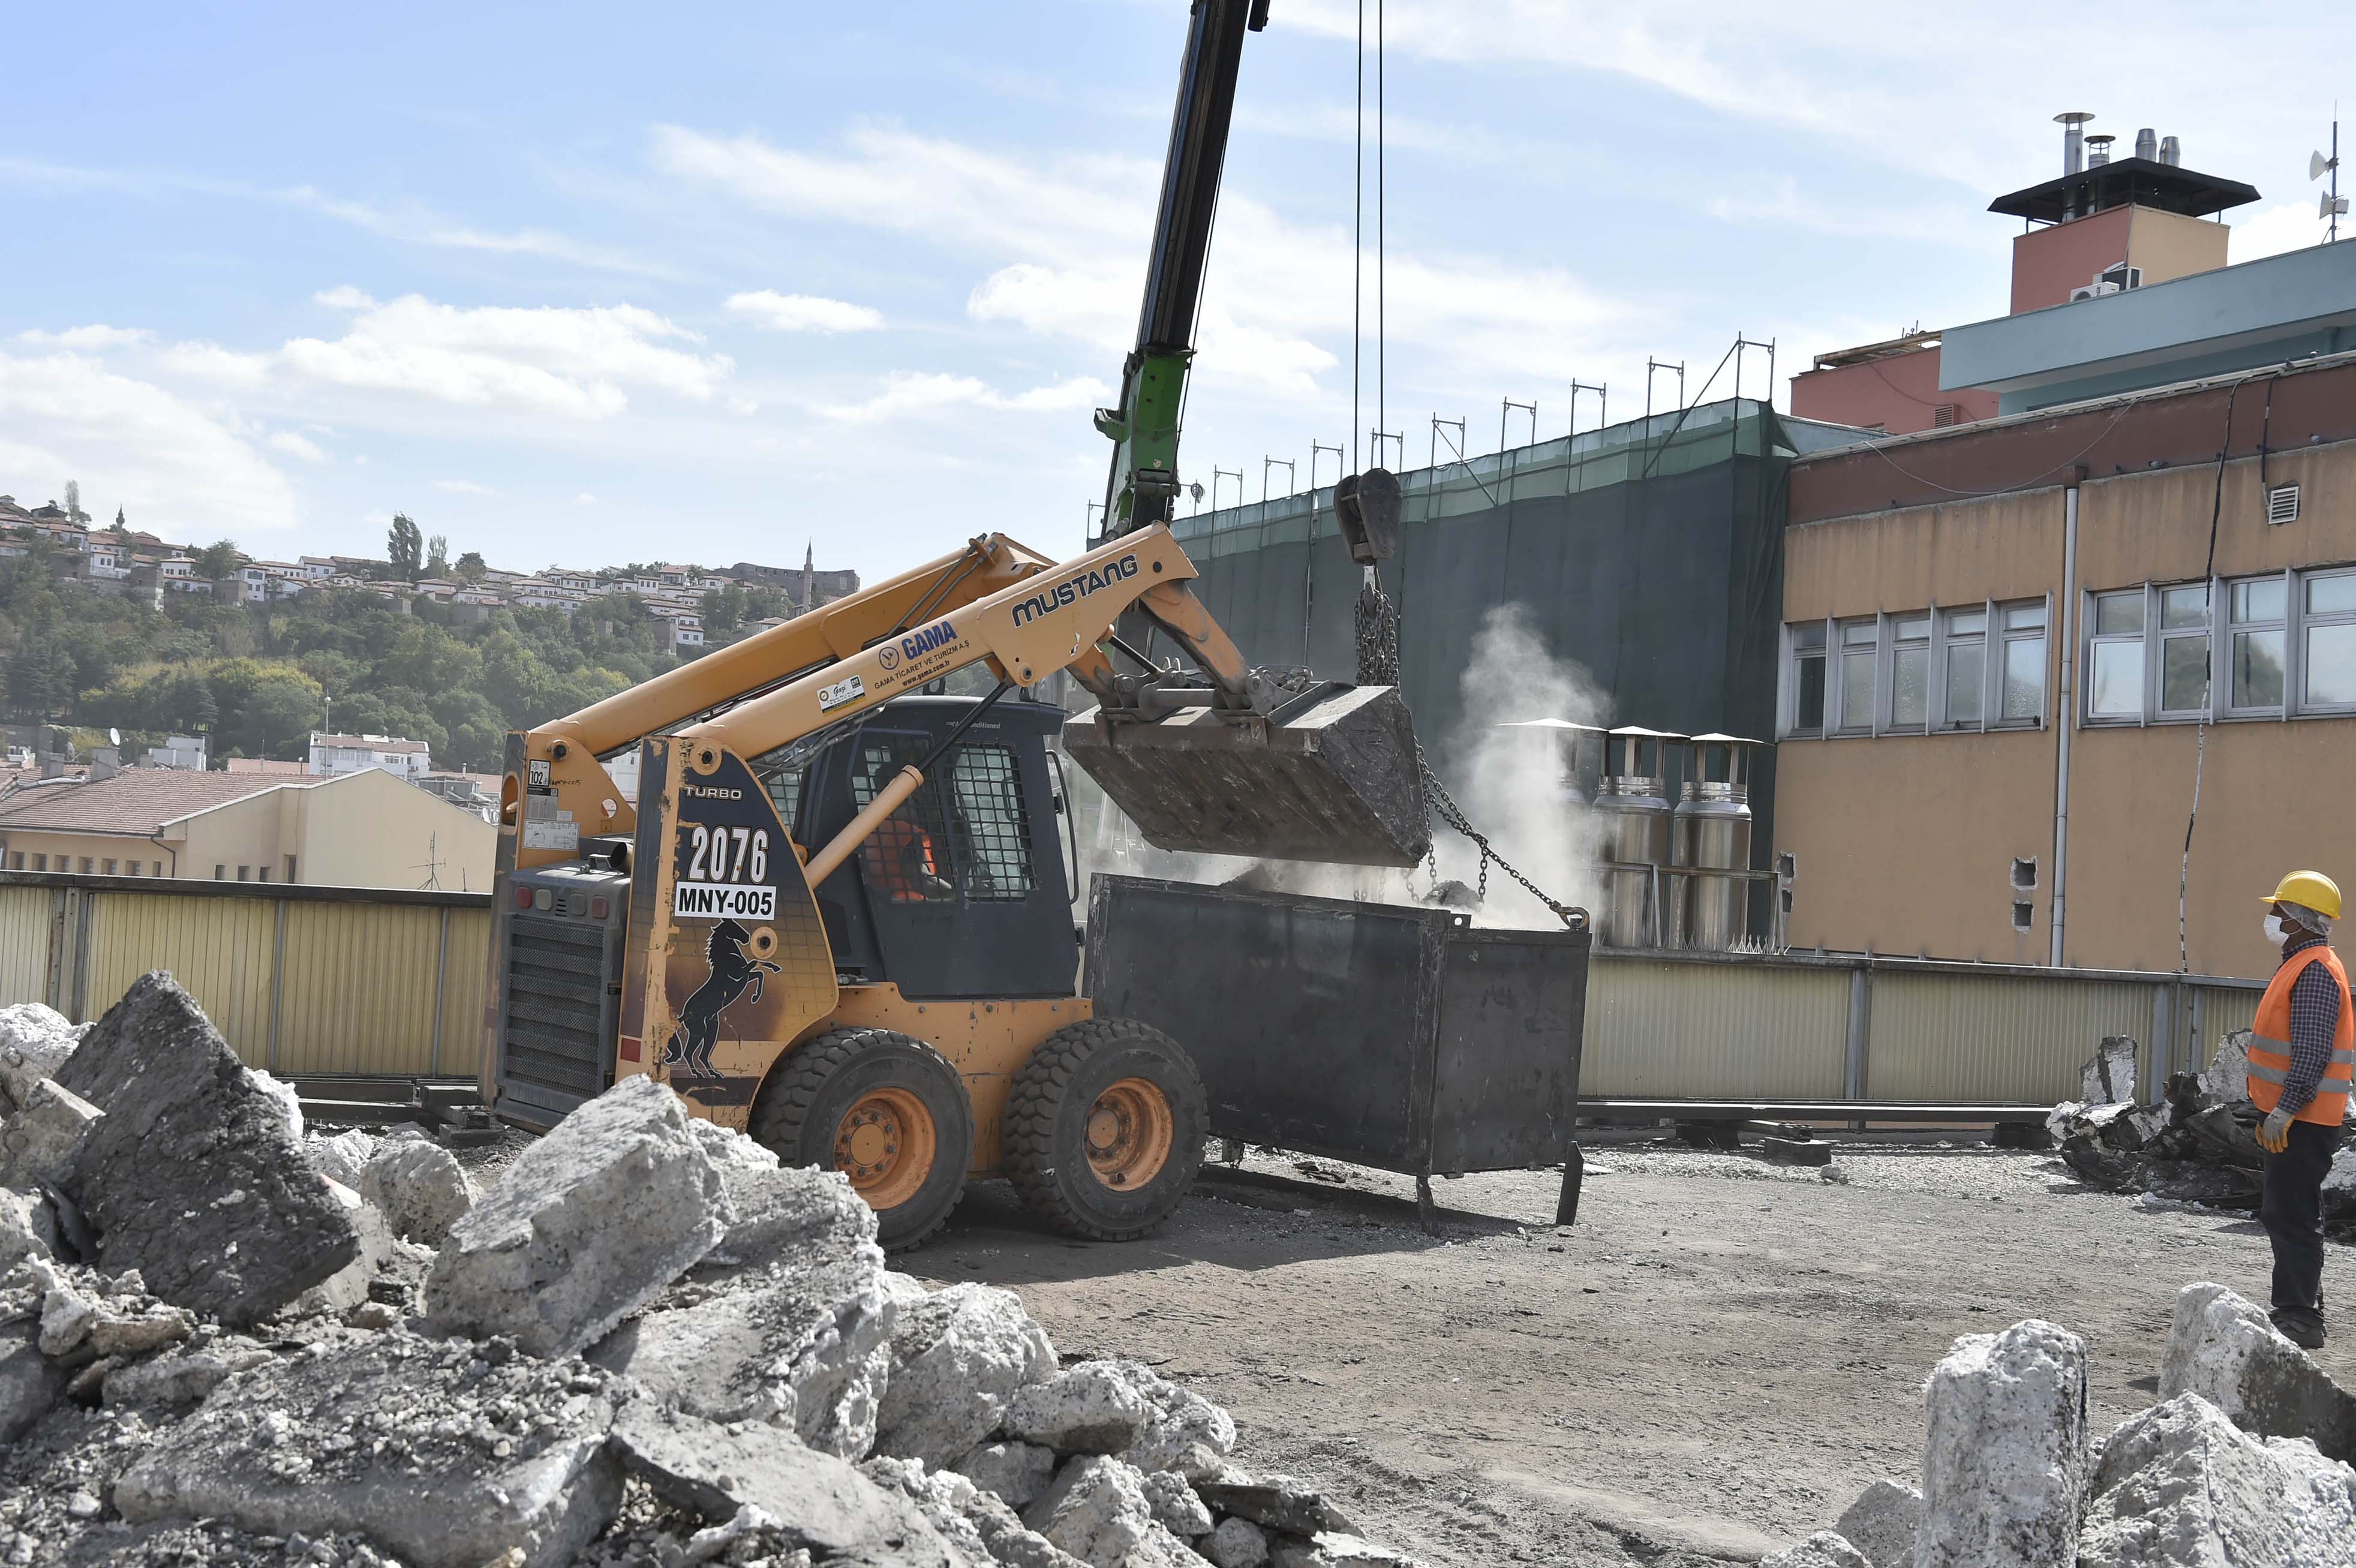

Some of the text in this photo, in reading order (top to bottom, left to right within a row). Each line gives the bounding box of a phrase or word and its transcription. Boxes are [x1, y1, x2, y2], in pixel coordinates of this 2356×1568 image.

[1012, 554, 1138, 627] MUSTANG
[901, 621, 958, 660] GAMA
[874, 675, 895, 689] GAMA
[895, 662, 922, 679] TİCARET
[924, 657, 933, 665] VE
[934, 646, 958, 660] TURİZM
[902, 660, 950, 686] www.gama.com.tr
[531, 771, 543, 784] 102
[684, 786, 742, 799] TURBO
[688, 826, 769, 884] 2076
[678, 888, 773, 915] MNY-005
